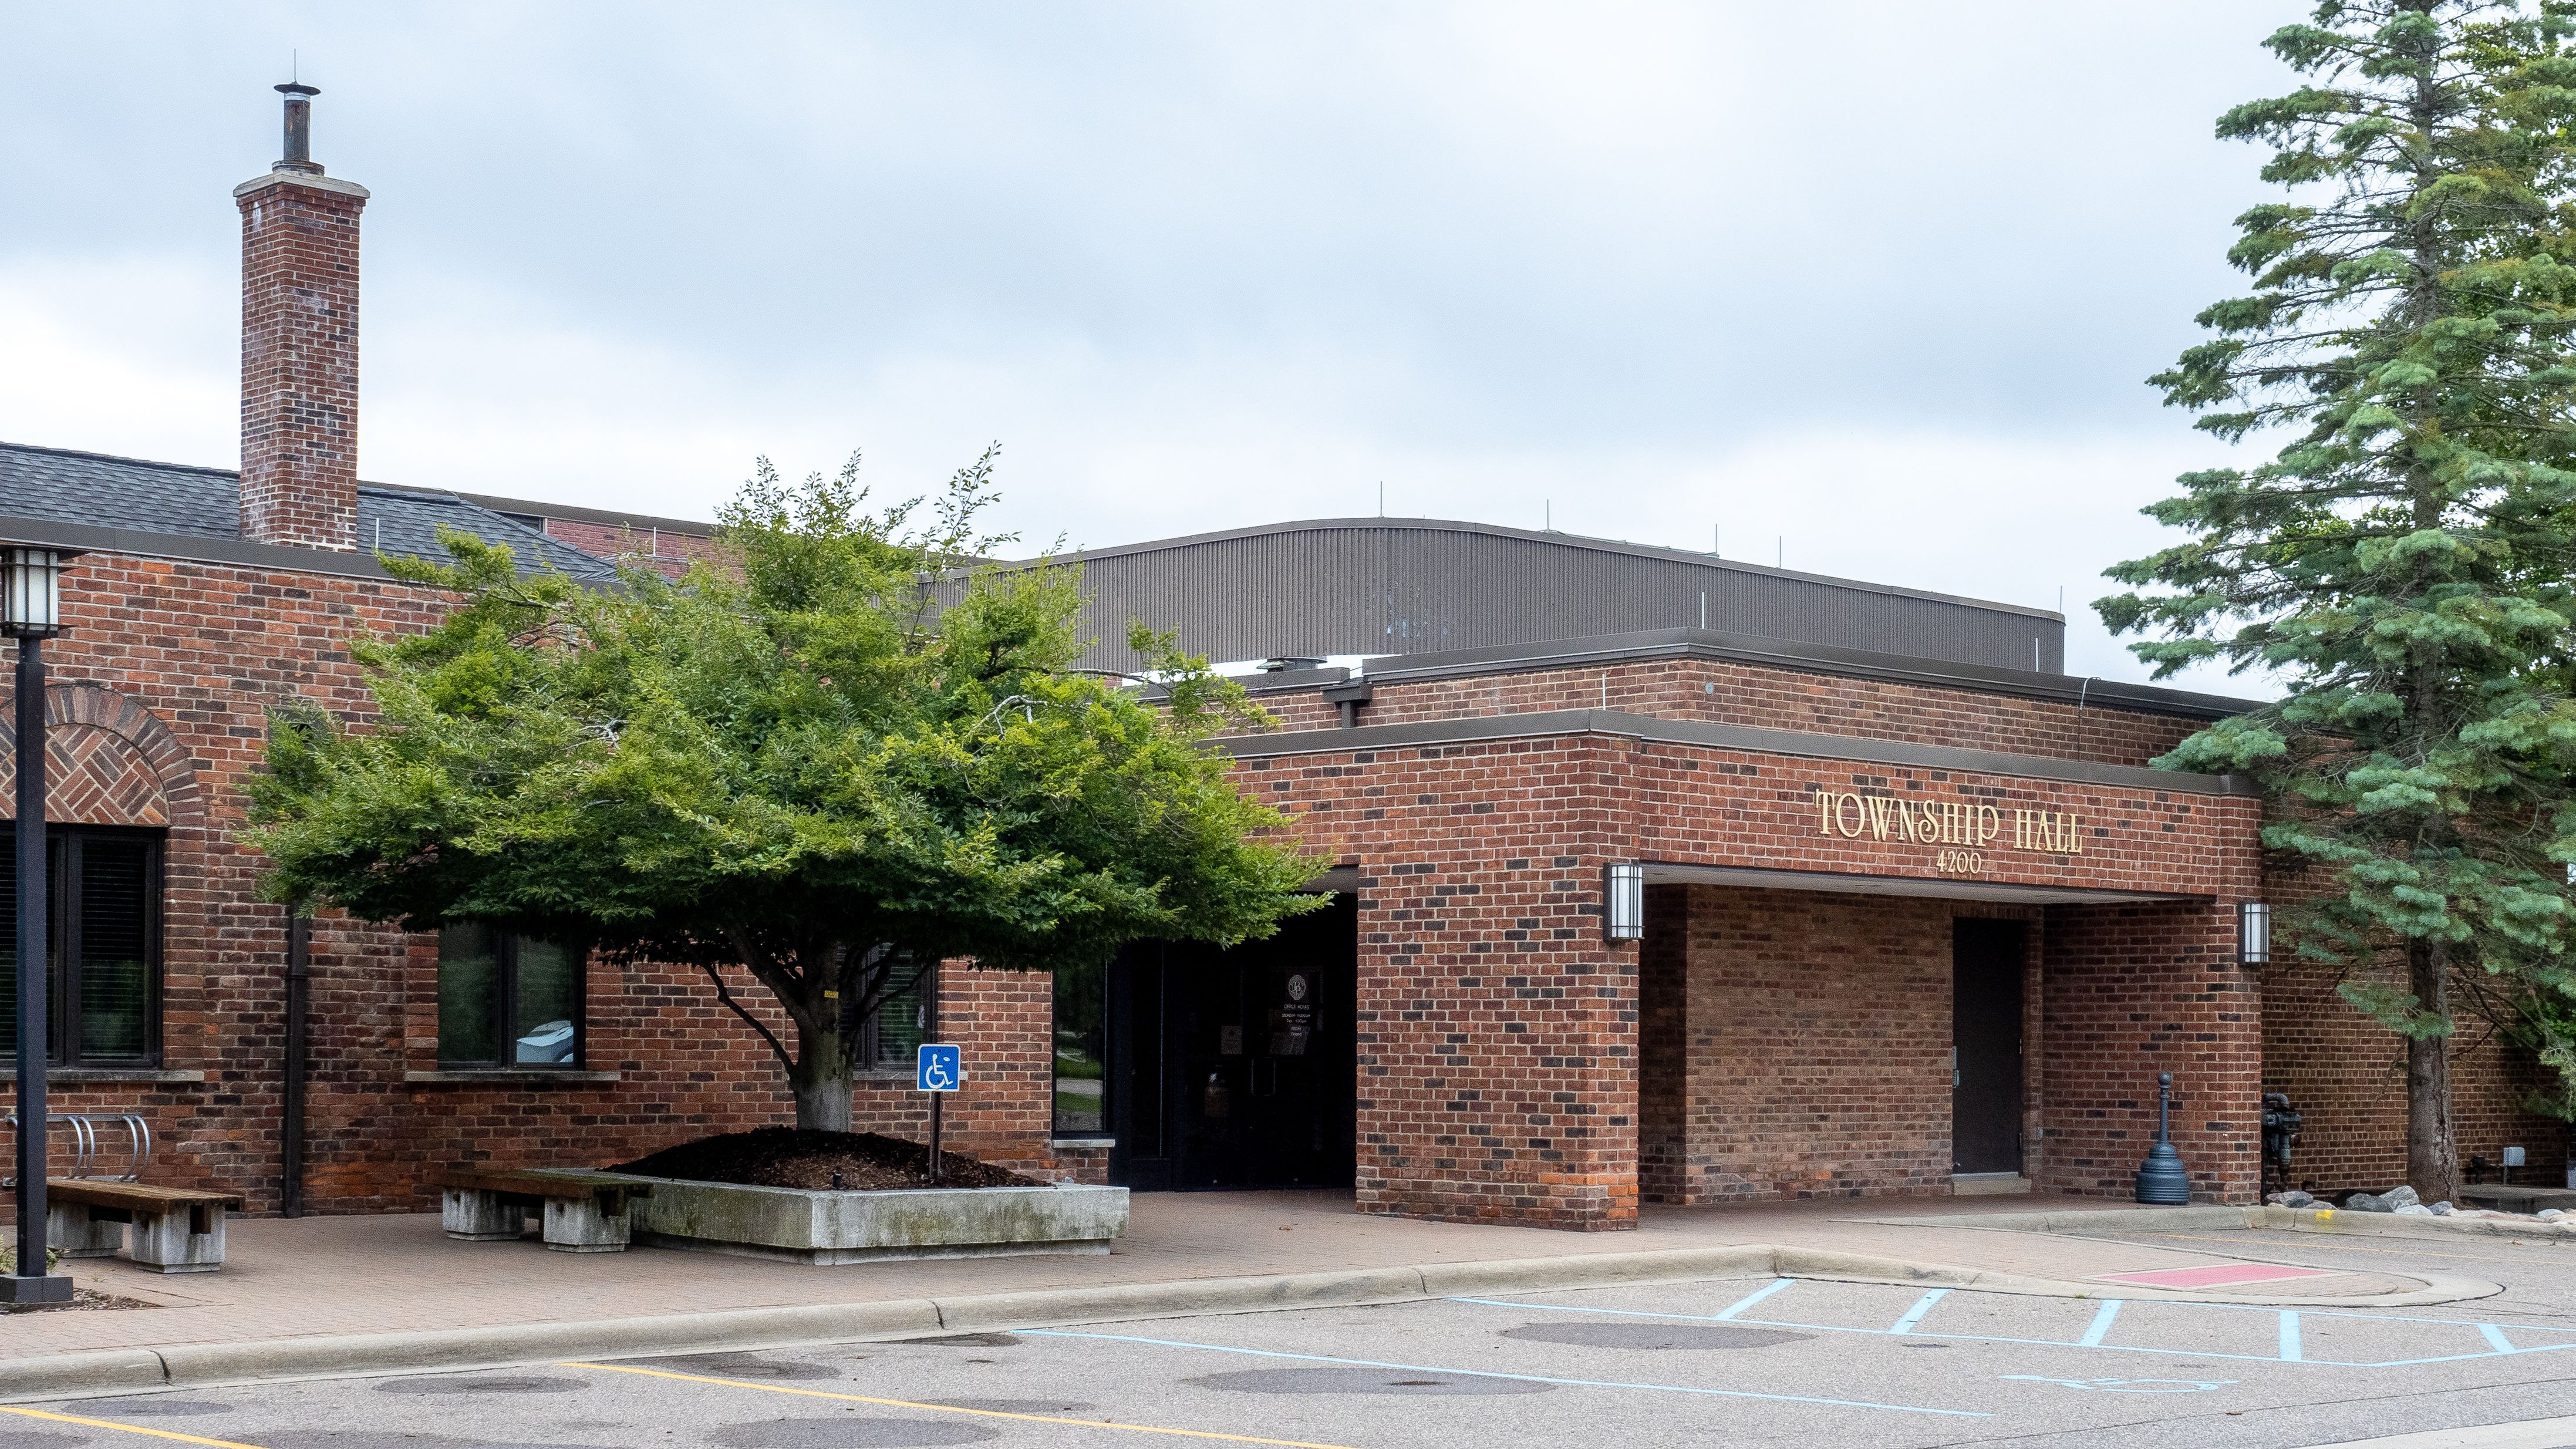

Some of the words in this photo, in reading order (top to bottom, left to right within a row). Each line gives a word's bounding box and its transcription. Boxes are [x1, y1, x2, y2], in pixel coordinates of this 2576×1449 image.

[1815, 788, 2000, 847] TOWNSHIP
[2013, 808, 2083, 855] HALL
[1936, 850, 1982, 874] 4200
